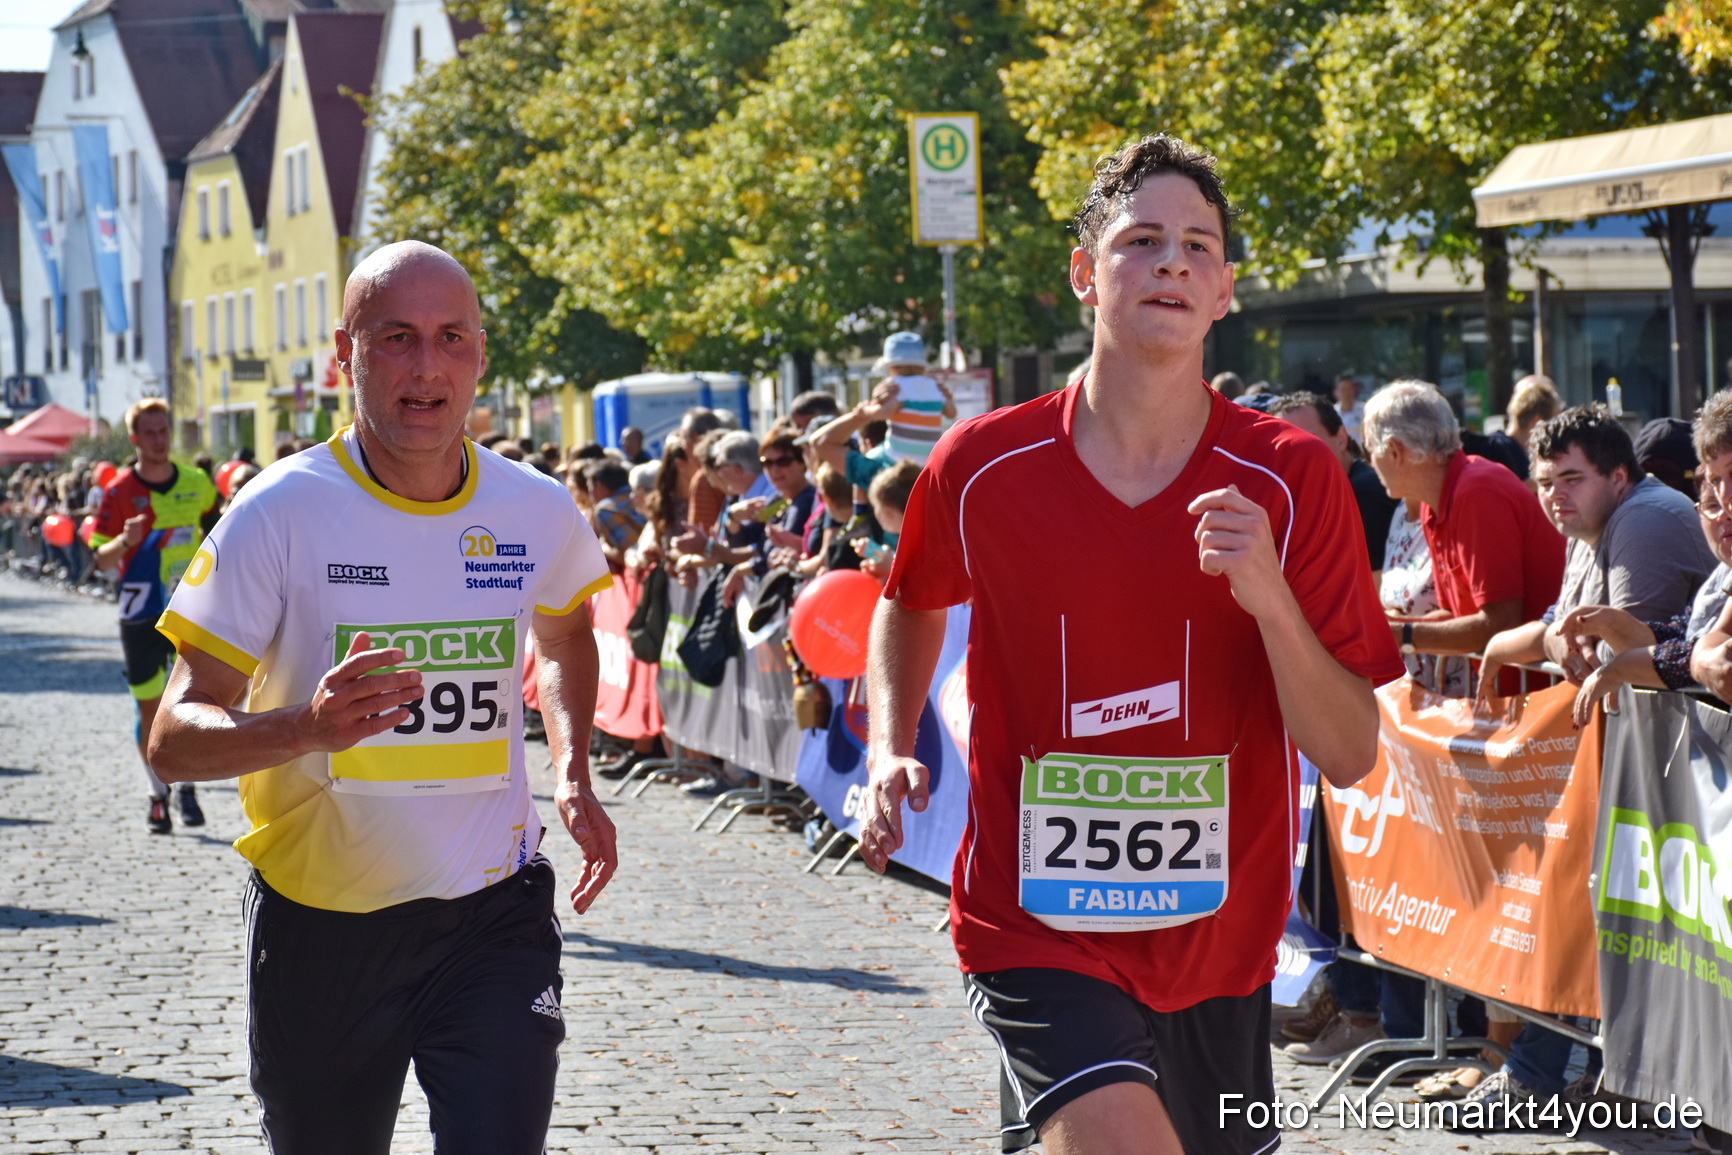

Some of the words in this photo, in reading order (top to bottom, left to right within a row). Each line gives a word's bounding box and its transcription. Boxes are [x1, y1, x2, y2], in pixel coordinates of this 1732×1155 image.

[464, 535, 495, 557] 20
[499, 545, 524, 554] JAHRE
[328, 564, 389, 580] BOCK
[465, 560, 535, 573] Neumarkter
[466, 577, 523, 590] Stadtlauf
[1100, 699, 1151, 725] DEHN
[1527, 735, 1577, 755] Partner
[1037, 760, 1213, 804] BOCK
[1510, 765, 1534, 783] und
[1473, 791, 1521, 814] Projekte
[1045, 816, 1201, 872] 2562
[1068, 888, 1179, 911] FABIAN
